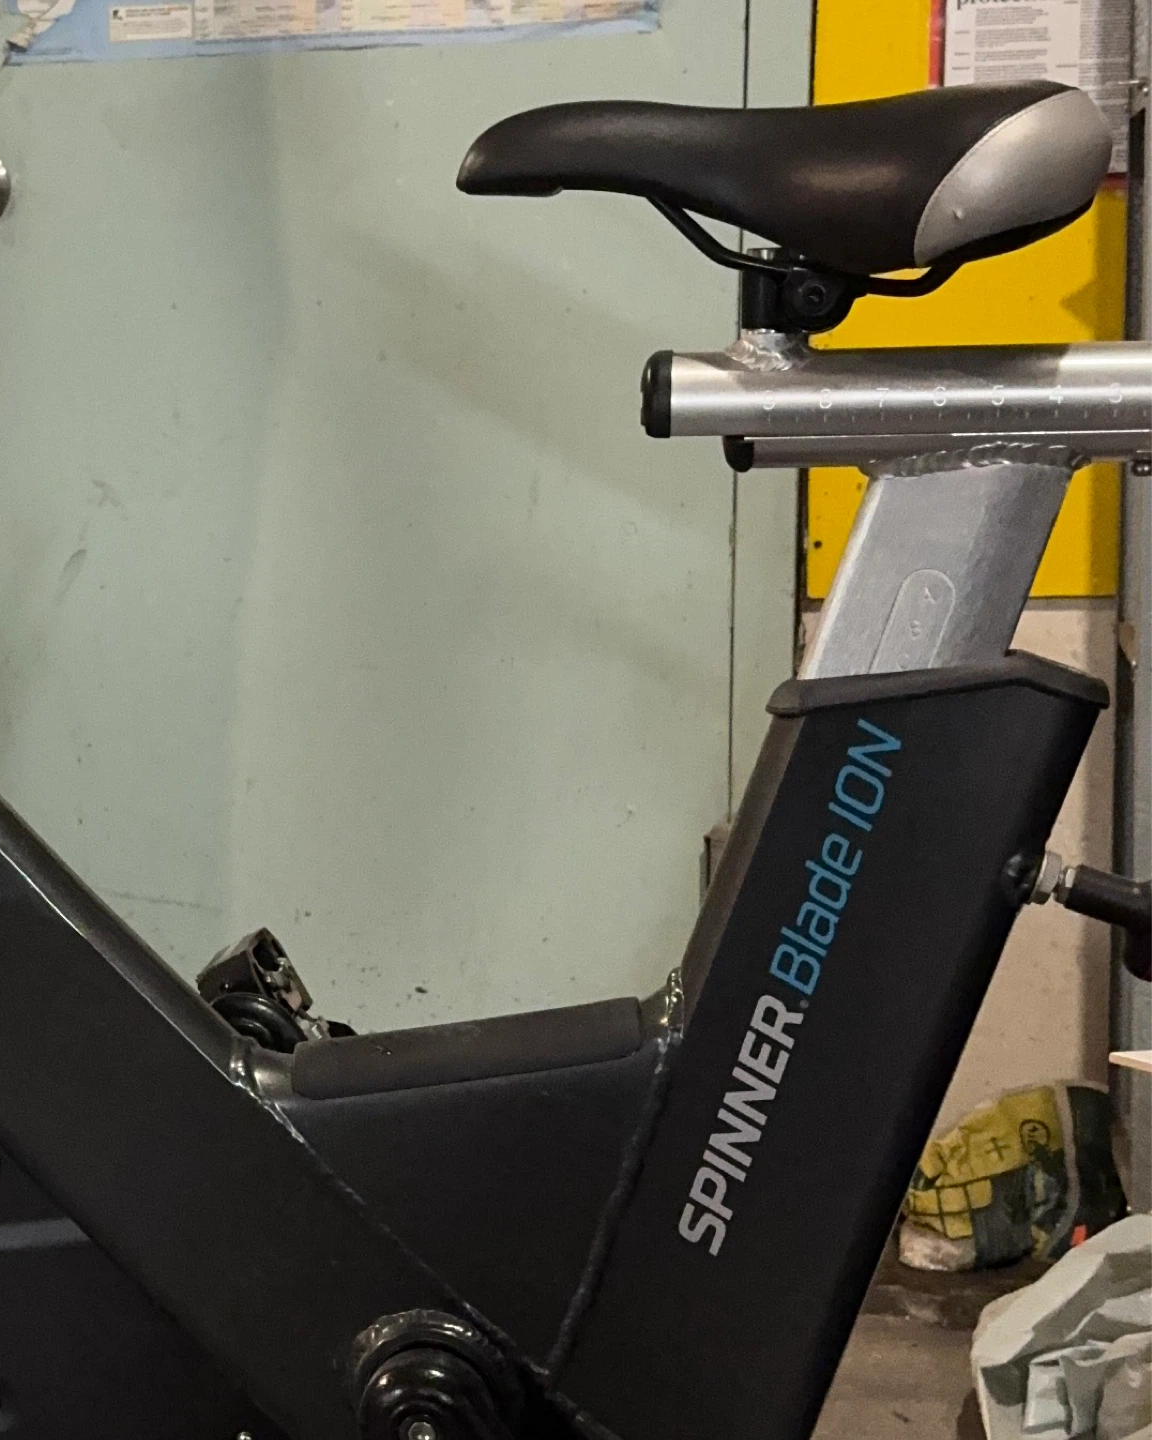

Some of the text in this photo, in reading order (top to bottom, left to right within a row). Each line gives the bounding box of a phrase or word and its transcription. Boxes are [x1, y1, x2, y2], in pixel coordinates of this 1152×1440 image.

[678, 717, 903, 1257] SPINNER Blade ION
